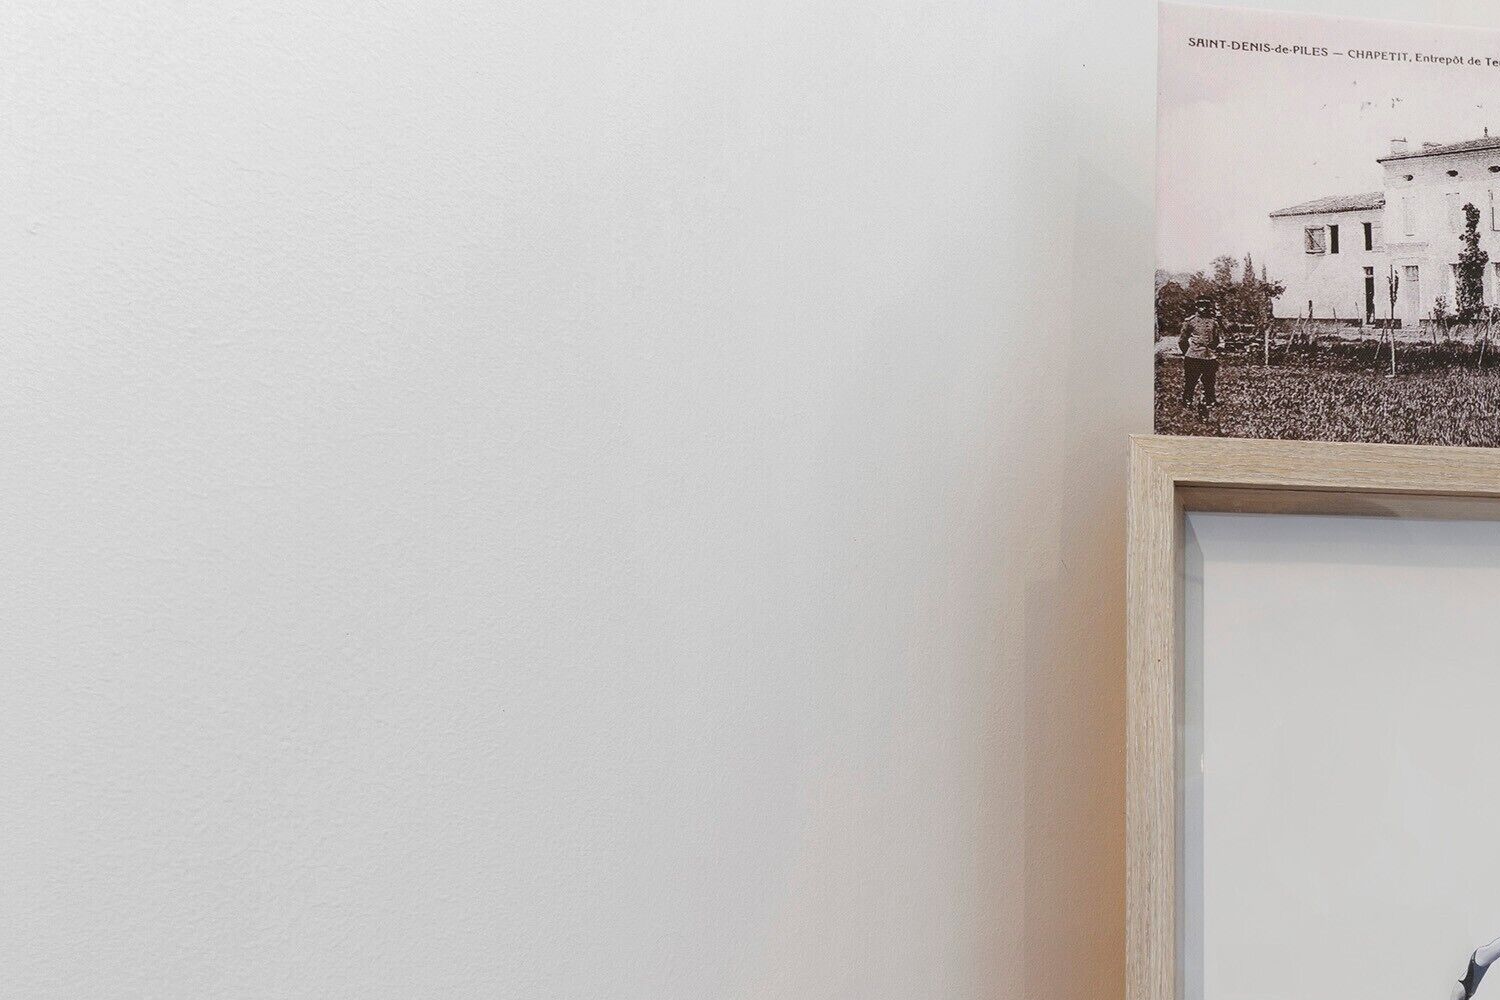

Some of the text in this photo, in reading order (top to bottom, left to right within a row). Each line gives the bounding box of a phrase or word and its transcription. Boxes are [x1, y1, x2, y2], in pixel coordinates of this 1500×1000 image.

[1188, 37, 1329, 57] SAINT-DENIS-de-PILES
[1347, 49, 1412, 62] CHAPETIT,
[1415, 52, 1464, 66] Entrepôt
[1467, 56, 1482, 66] de
